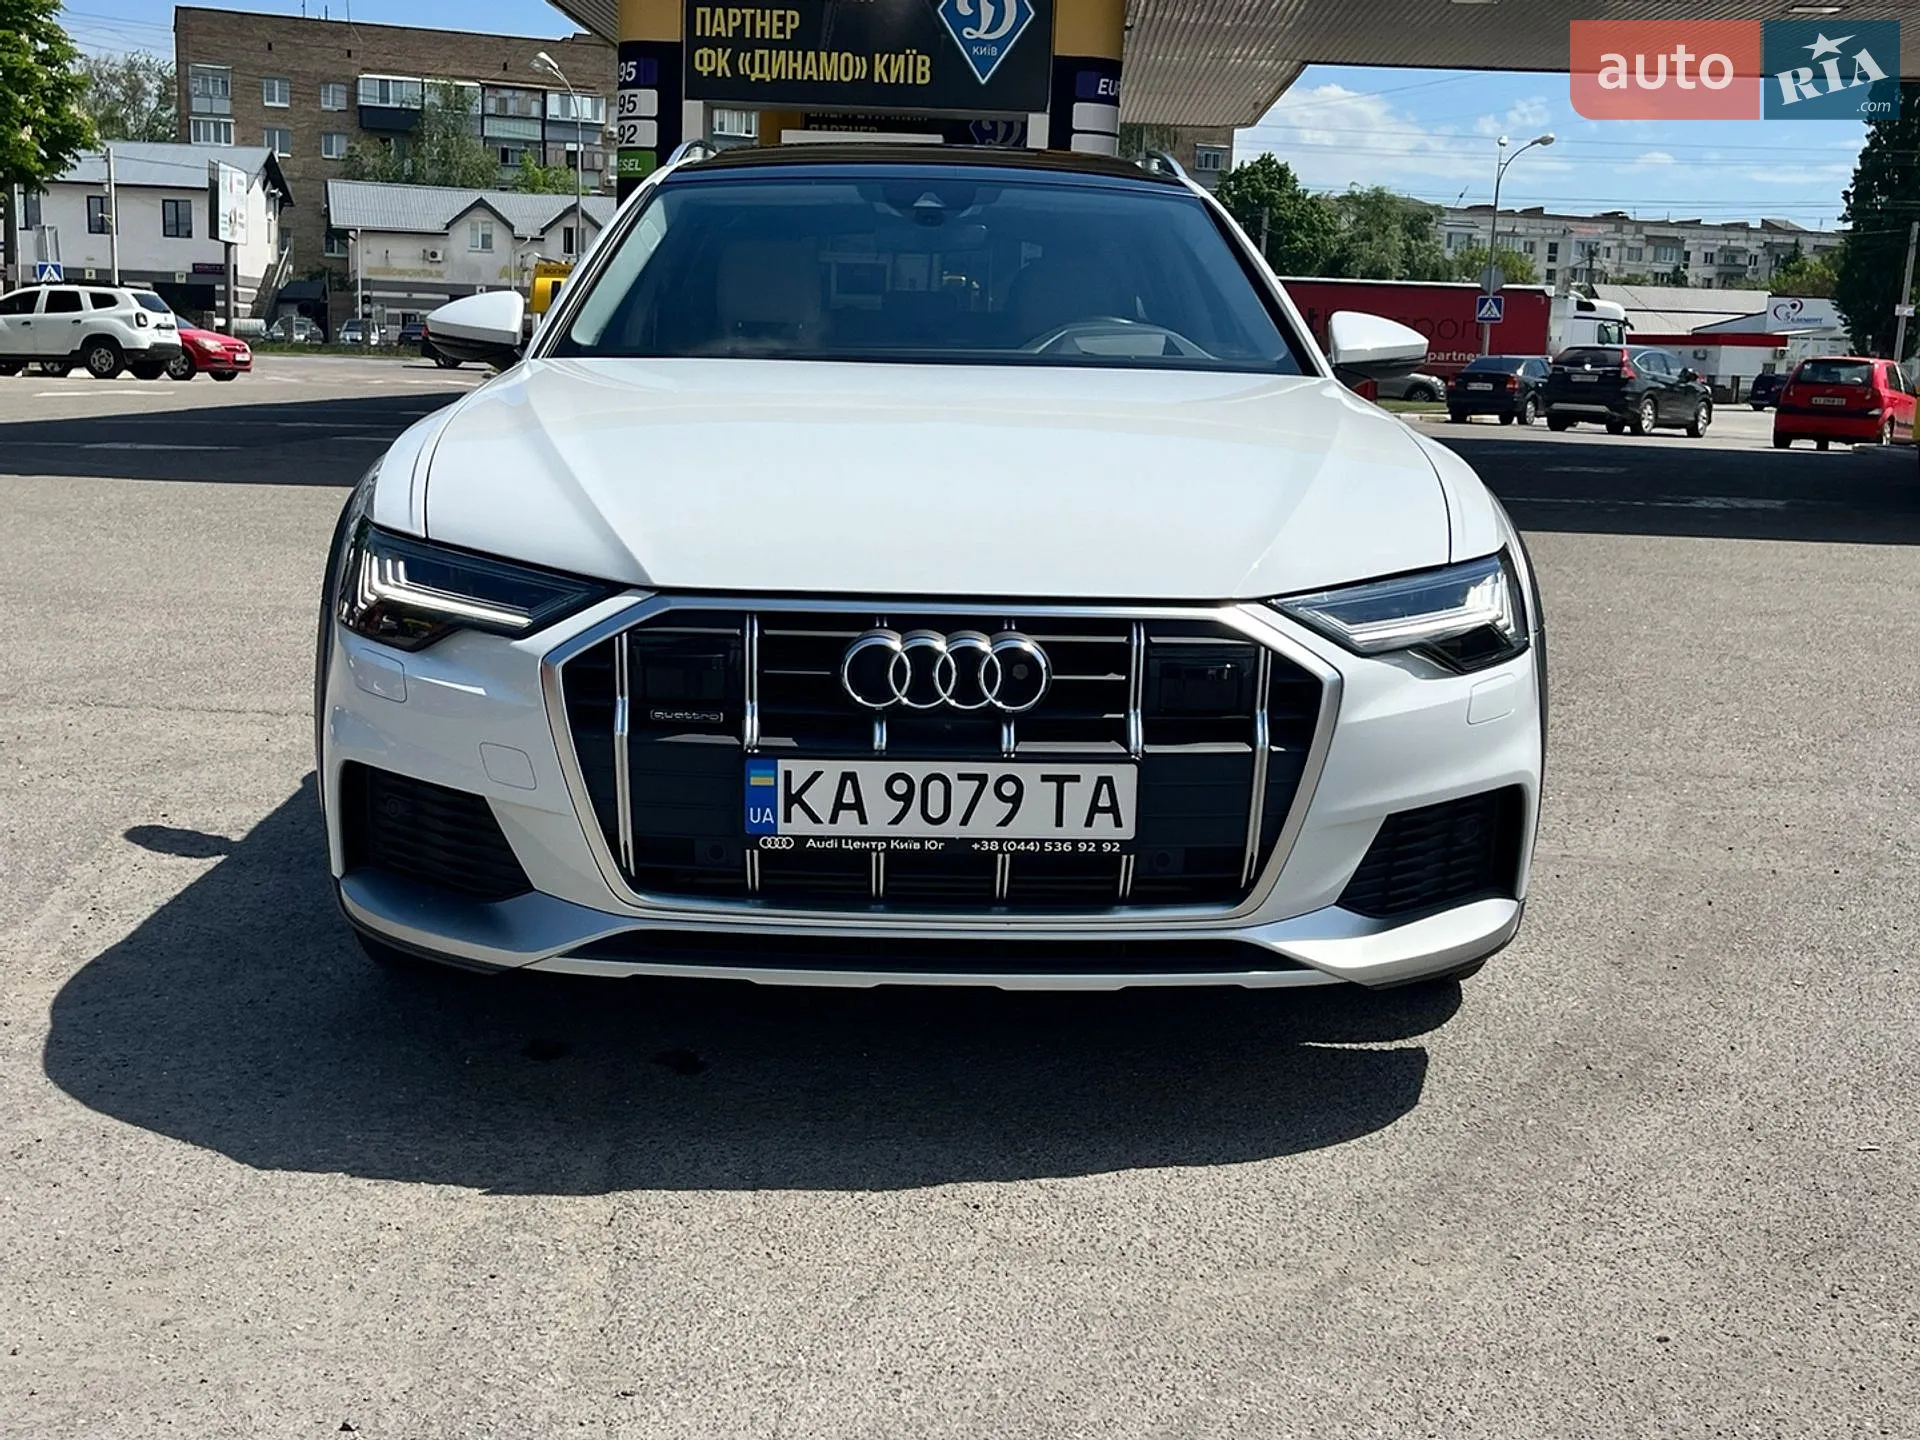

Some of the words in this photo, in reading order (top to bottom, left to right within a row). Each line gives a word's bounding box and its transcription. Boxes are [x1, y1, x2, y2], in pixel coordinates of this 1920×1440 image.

[695, 6, 800, 40] ПАРТНЕР
[972, 43, 998, 57] КИЇВ
[619, 61, 637, 82] 95
[694, 47, 732, 78] ФК
[737, 48, 868, 82] «ДИНАМО»
[873, 49, 931, 85] КИЇВ
[619, 94, 638, 114] 95
[618, 124, 637, 144] 92
[782, 769, 869, 825] KA
[883, 772, 1025, 828] 9079
[1040, 774, 1124, 829] TA
[750, 807, 774, 824] UA
[805, 838, 838, 849] Audi
[841, 839, 887, 852] Центр
[890, 839, 921, 850] Київ
[924, 840, 945, 851] Юг
[971, 840, 999, 851] +38
[1002, 841, 1040, 852] (044)
[1044, 841, 1072, 852] 536
[1077, 842, 1096, 852] 92
[1102, 842, 1121, 852] 92
